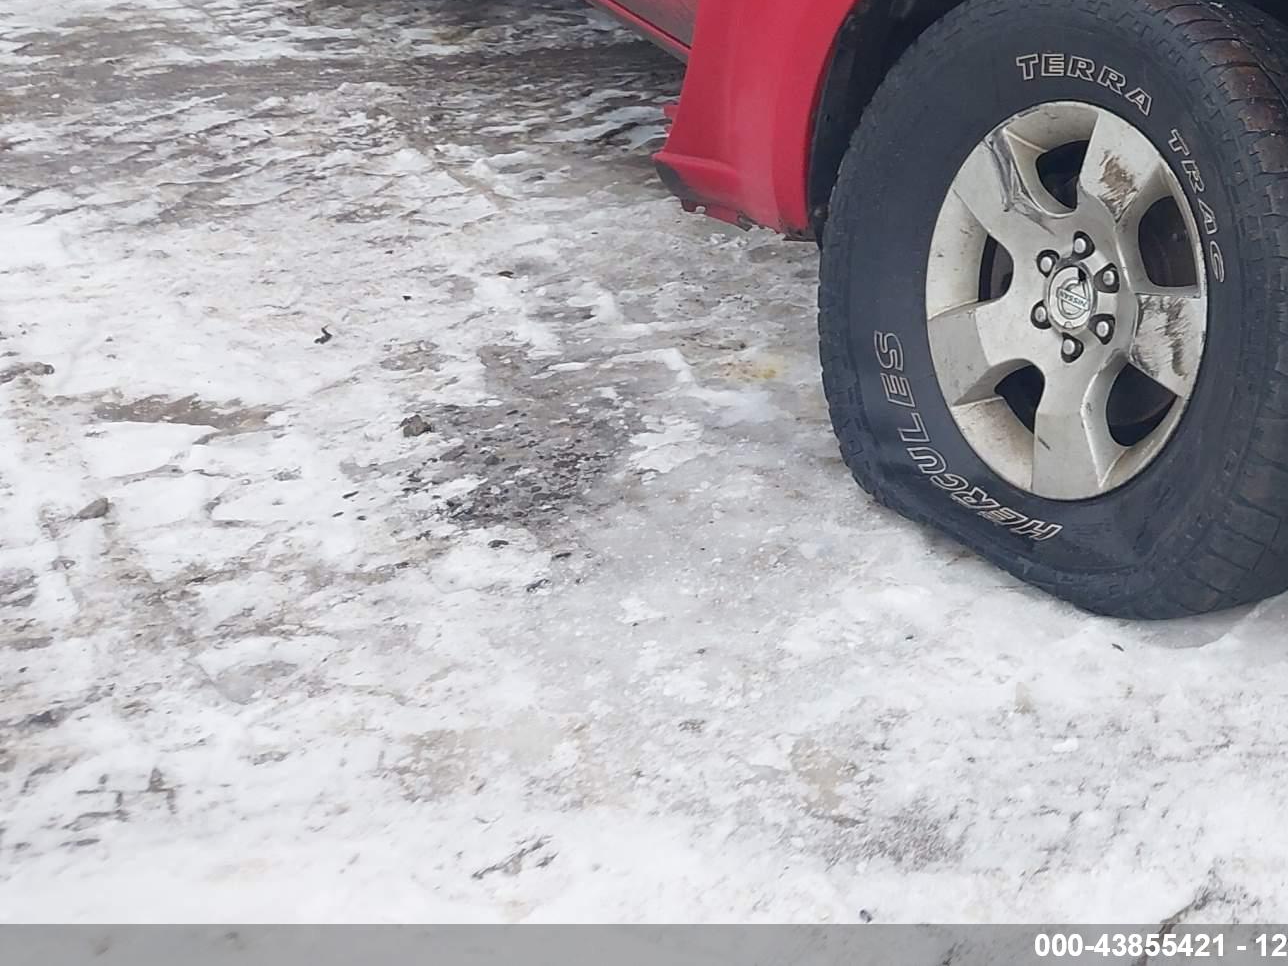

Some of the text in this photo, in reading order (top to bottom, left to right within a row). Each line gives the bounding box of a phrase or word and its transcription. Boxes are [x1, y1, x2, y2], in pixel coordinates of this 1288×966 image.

[1016, 53, 1226, 284] TERRA TRAC
[874, 330, 1063, 542] HERCULES
